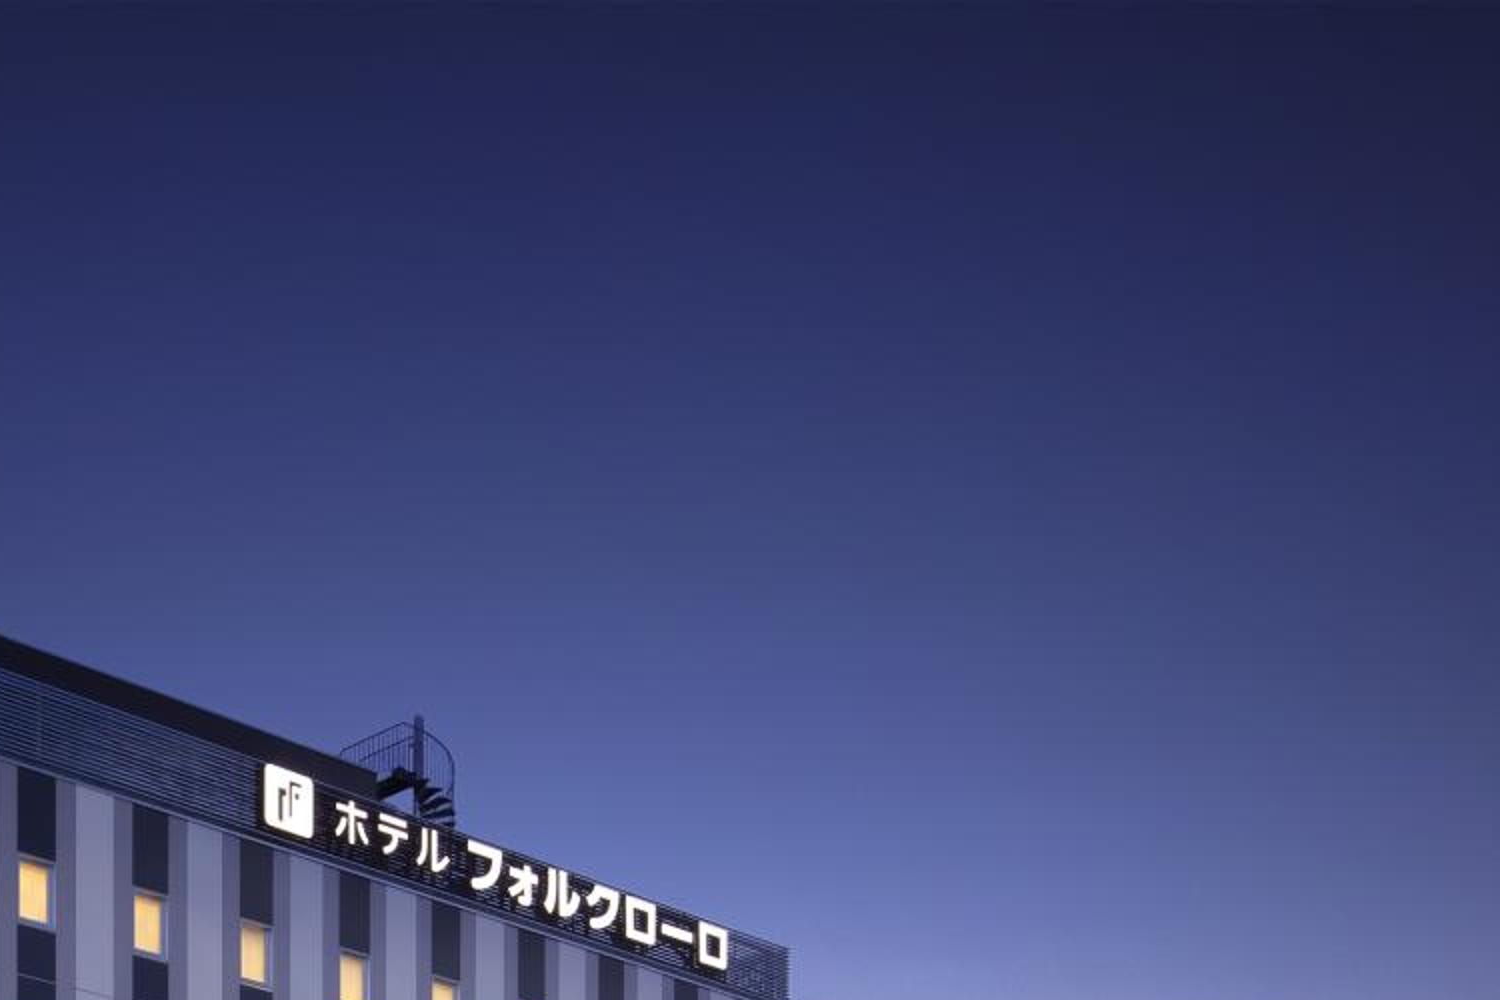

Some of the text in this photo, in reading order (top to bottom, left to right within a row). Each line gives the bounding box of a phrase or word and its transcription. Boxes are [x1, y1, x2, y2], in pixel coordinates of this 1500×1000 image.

[335, 800, 728, 970] ホテル フォルクローロ
